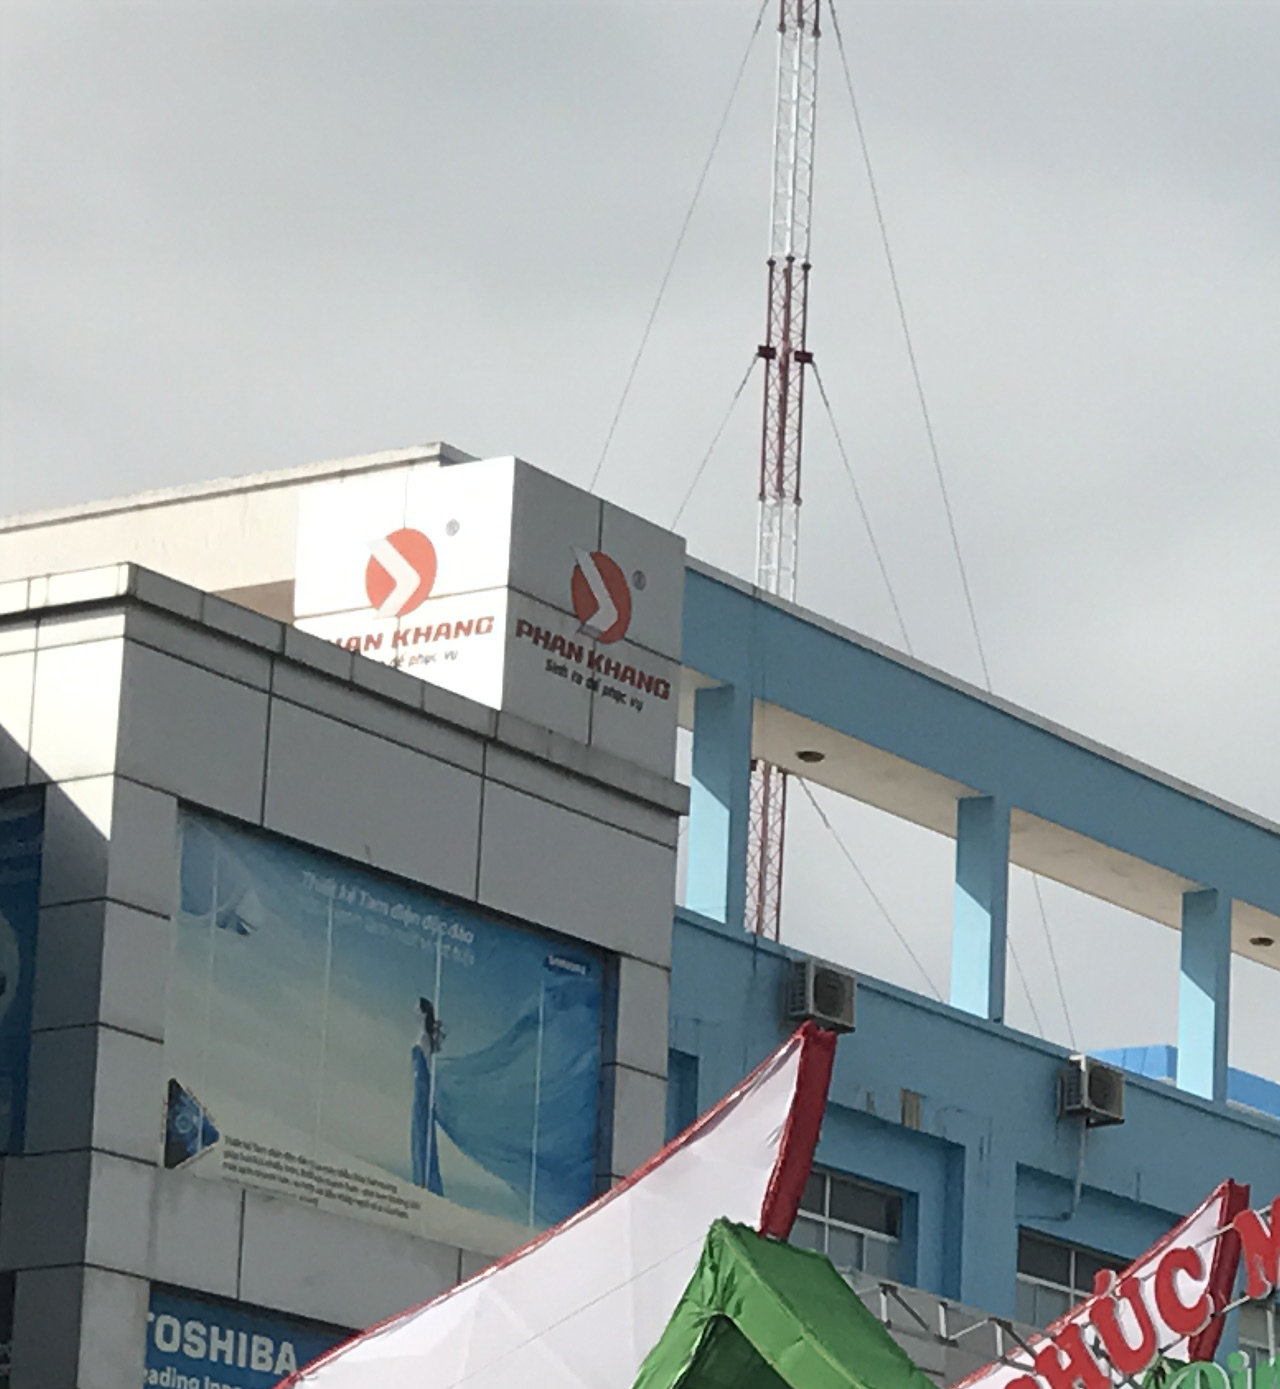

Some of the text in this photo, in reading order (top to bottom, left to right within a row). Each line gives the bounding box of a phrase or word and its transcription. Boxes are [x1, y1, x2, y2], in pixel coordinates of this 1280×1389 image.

[391, 616, 495, 648] KHANG
[515, 618, 671, 700] PHAN KHANG
[148, 1311, 298, 1376] OSHIBA
